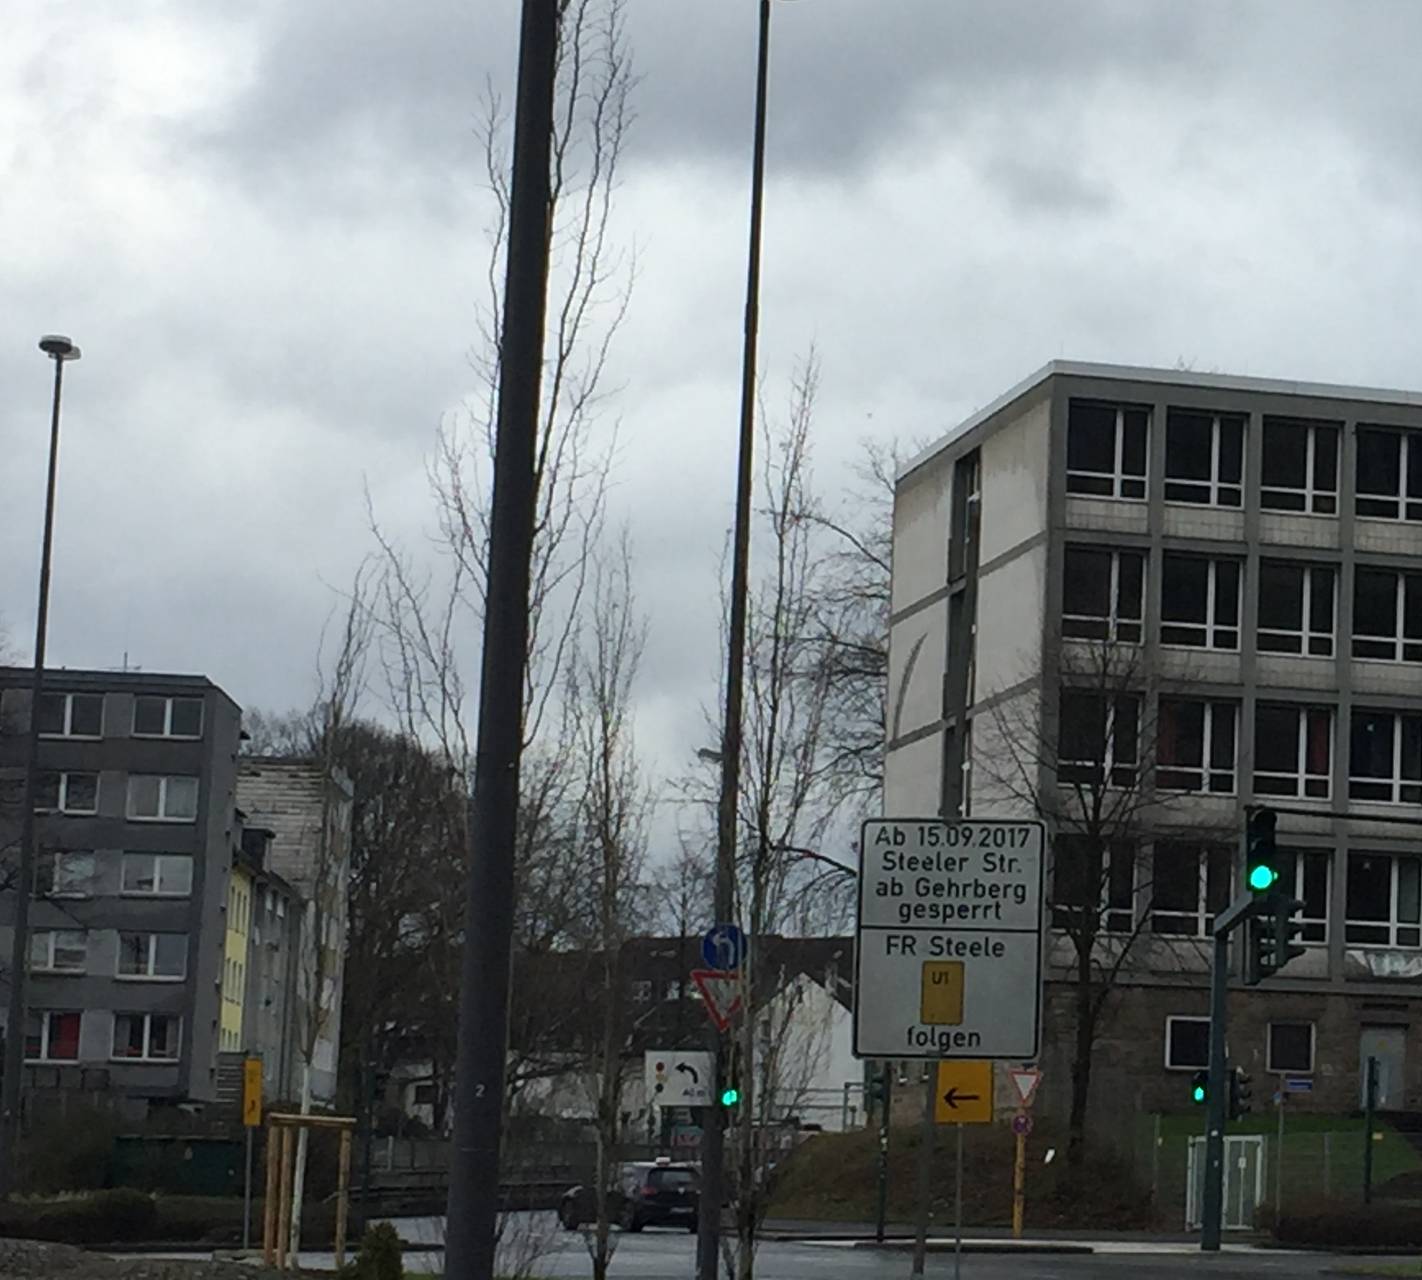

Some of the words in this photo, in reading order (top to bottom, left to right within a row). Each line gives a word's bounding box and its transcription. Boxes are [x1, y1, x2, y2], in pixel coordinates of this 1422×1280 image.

[875, 826, 906, 847] Ab
[918, 826, 1030, 848] 15.09.2017
[882, 850, 969, 873] Steeler
[982, 852, 1022, 873] Str.
[875, 877, 904, 897] ab
[915, 877, 1026, 904] Gehrberg
[899, 902, 1002, 924] gesperrt
[886, 935, 917, 956] FR
[929, 936, 1005, 957] Steele
[931, 971, 949, 985] U1
[907, 1026, 981, 1050] folgen
[475, 1084, 485, 1097] 2
